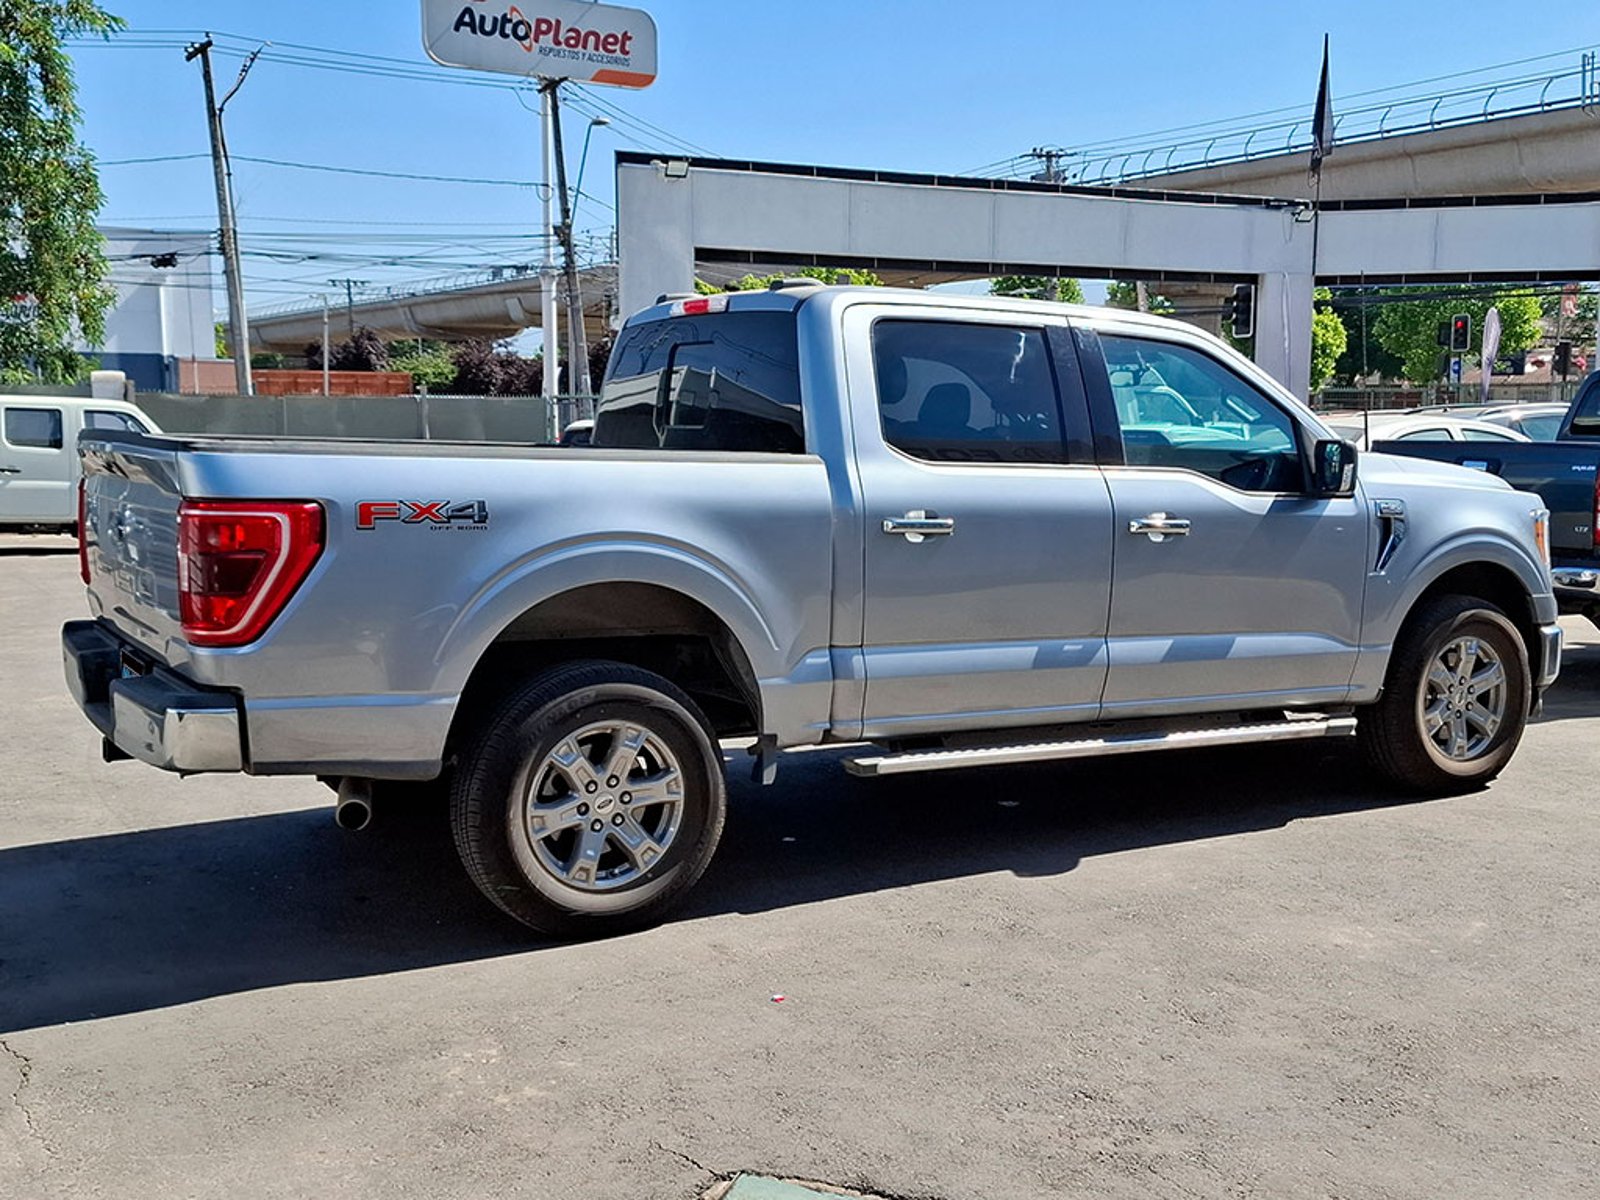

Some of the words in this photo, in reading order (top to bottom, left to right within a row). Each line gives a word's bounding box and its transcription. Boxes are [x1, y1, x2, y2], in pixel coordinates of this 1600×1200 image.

[453, 6, 634, 56] AutoPlanet
[538, 45, 580, 60] REPUESTOS
[580, 52, 586, 60] Y
[586, 53, 631, 67] ACCESORIOS
[355, 499, 488, 530] FX4
